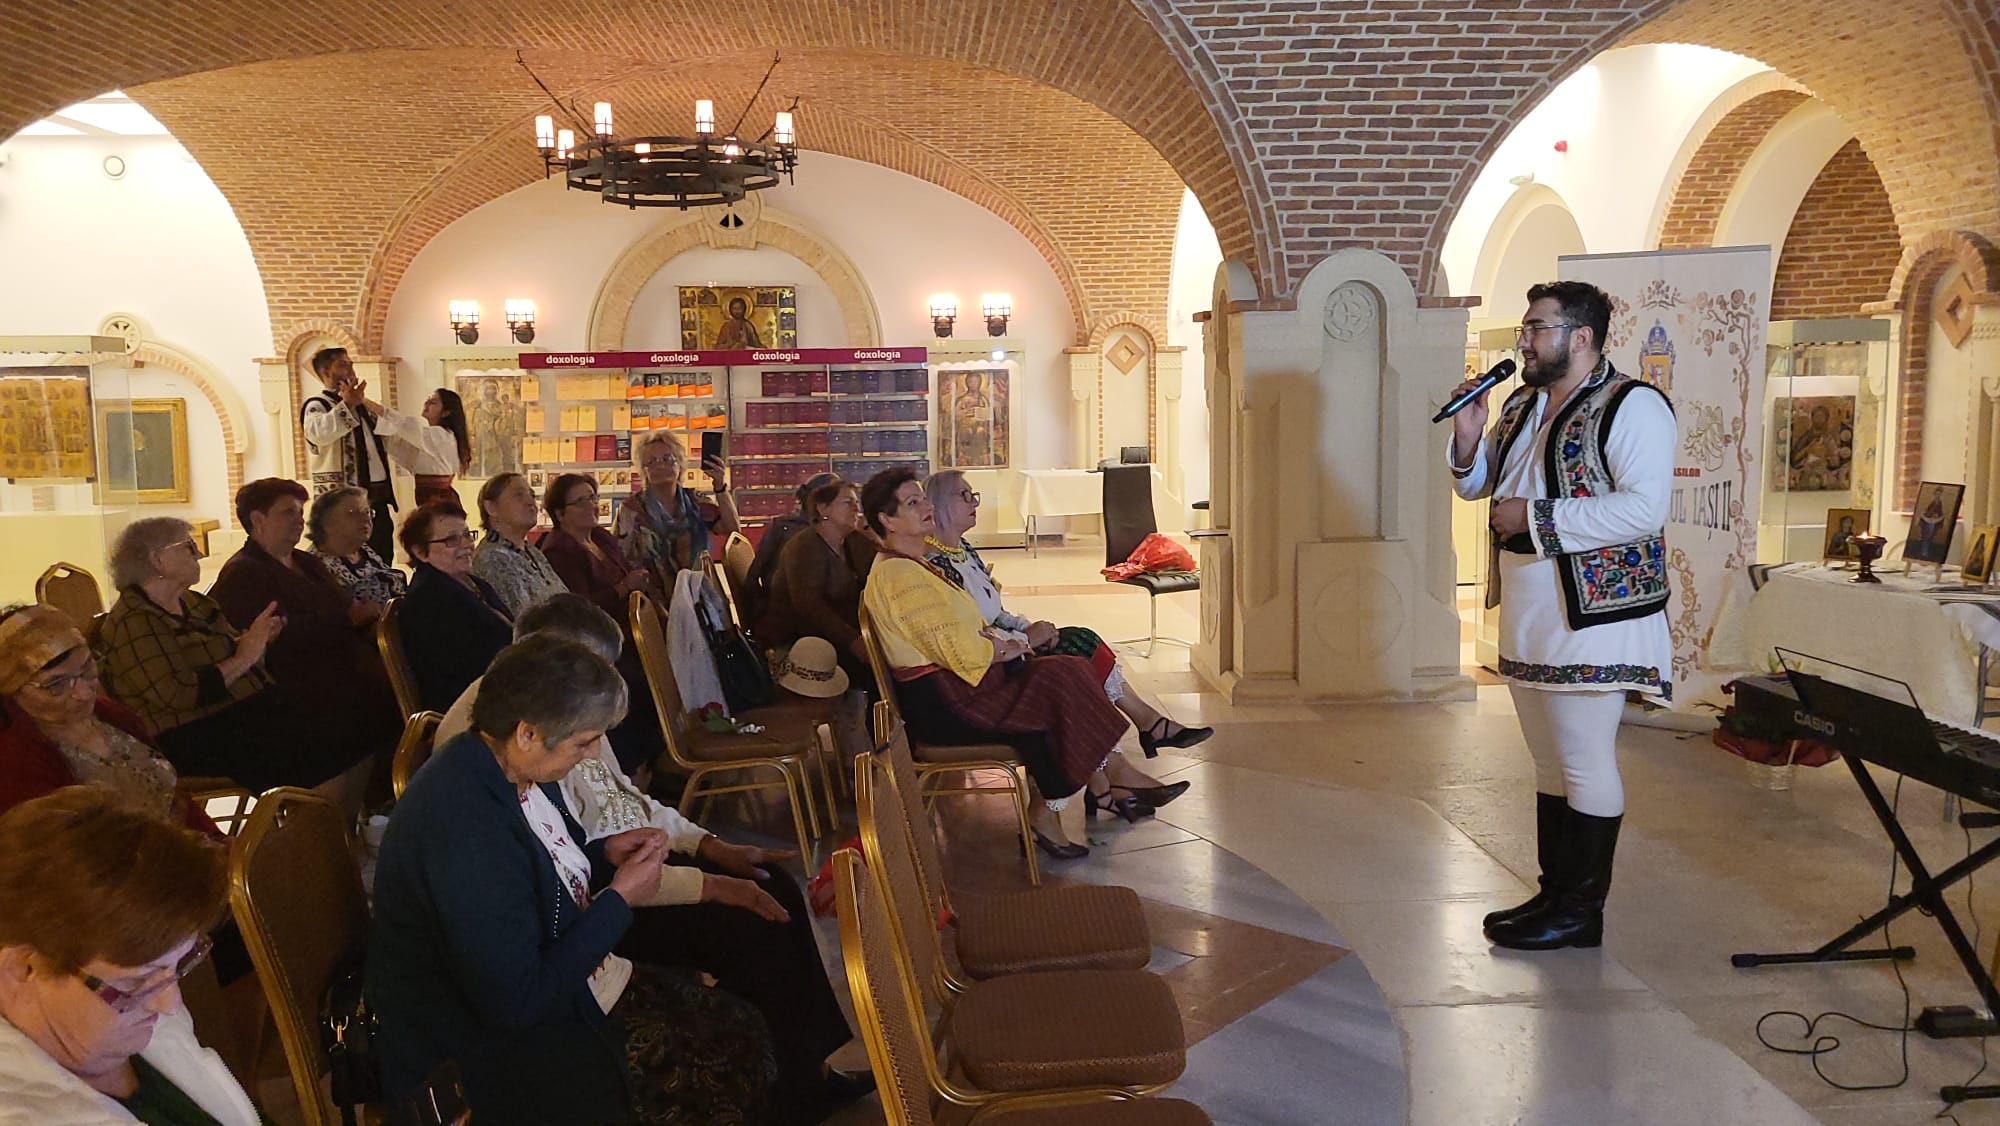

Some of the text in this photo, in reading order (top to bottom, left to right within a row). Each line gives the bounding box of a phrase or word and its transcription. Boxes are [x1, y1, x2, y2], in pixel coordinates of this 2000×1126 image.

[545, 355, 595, 365] doxologia
[650, 353, 699, 363] doxologia
[752, 351, 800, 361] doxologia
[854, 350, 901, 360] doxologia
[1794, 710, 1835, 735] CASIO
